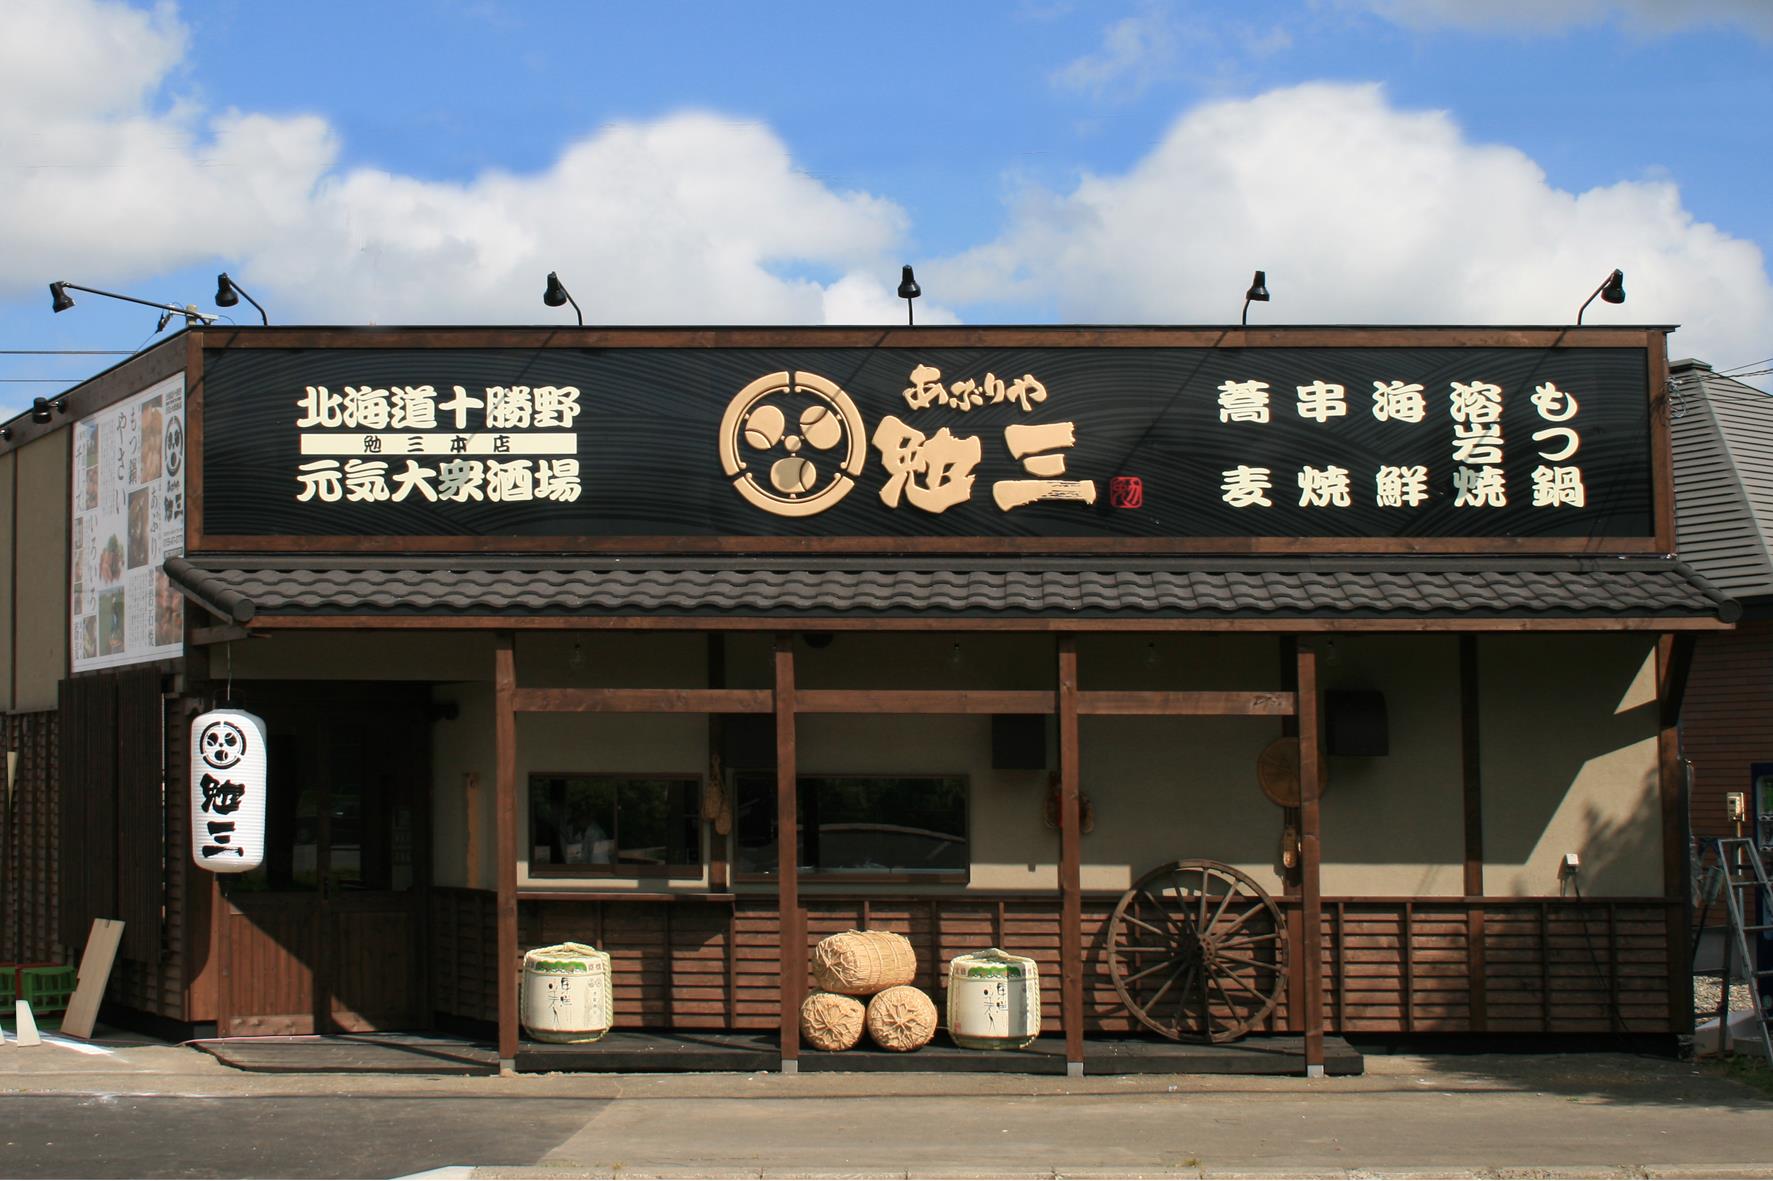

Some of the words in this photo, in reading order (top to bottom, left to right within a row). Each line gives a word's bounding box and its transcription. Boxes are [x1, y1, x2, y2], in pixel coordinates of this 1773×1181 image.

[296, 385, 581, 430] 北海道十勝野
[902, 363, 1048, 412] あぶりや
[296, 458, 581, 503] 元気大衆酒場
[363, 435, 511, 454] 勉三本店
[871, 415, 1097, 514] 勉三
[1216, 379, 1273, 508] 蕎麦
[1295, 380, 1352, 508] 串焼
[1372, 380, 1430, 508] 海鮮
[1449, 380, 1508, 508] 溶岩焼
[1530, 382, 1585, 508] もつ鍋
[200, 773, 246, 858] 勉三
